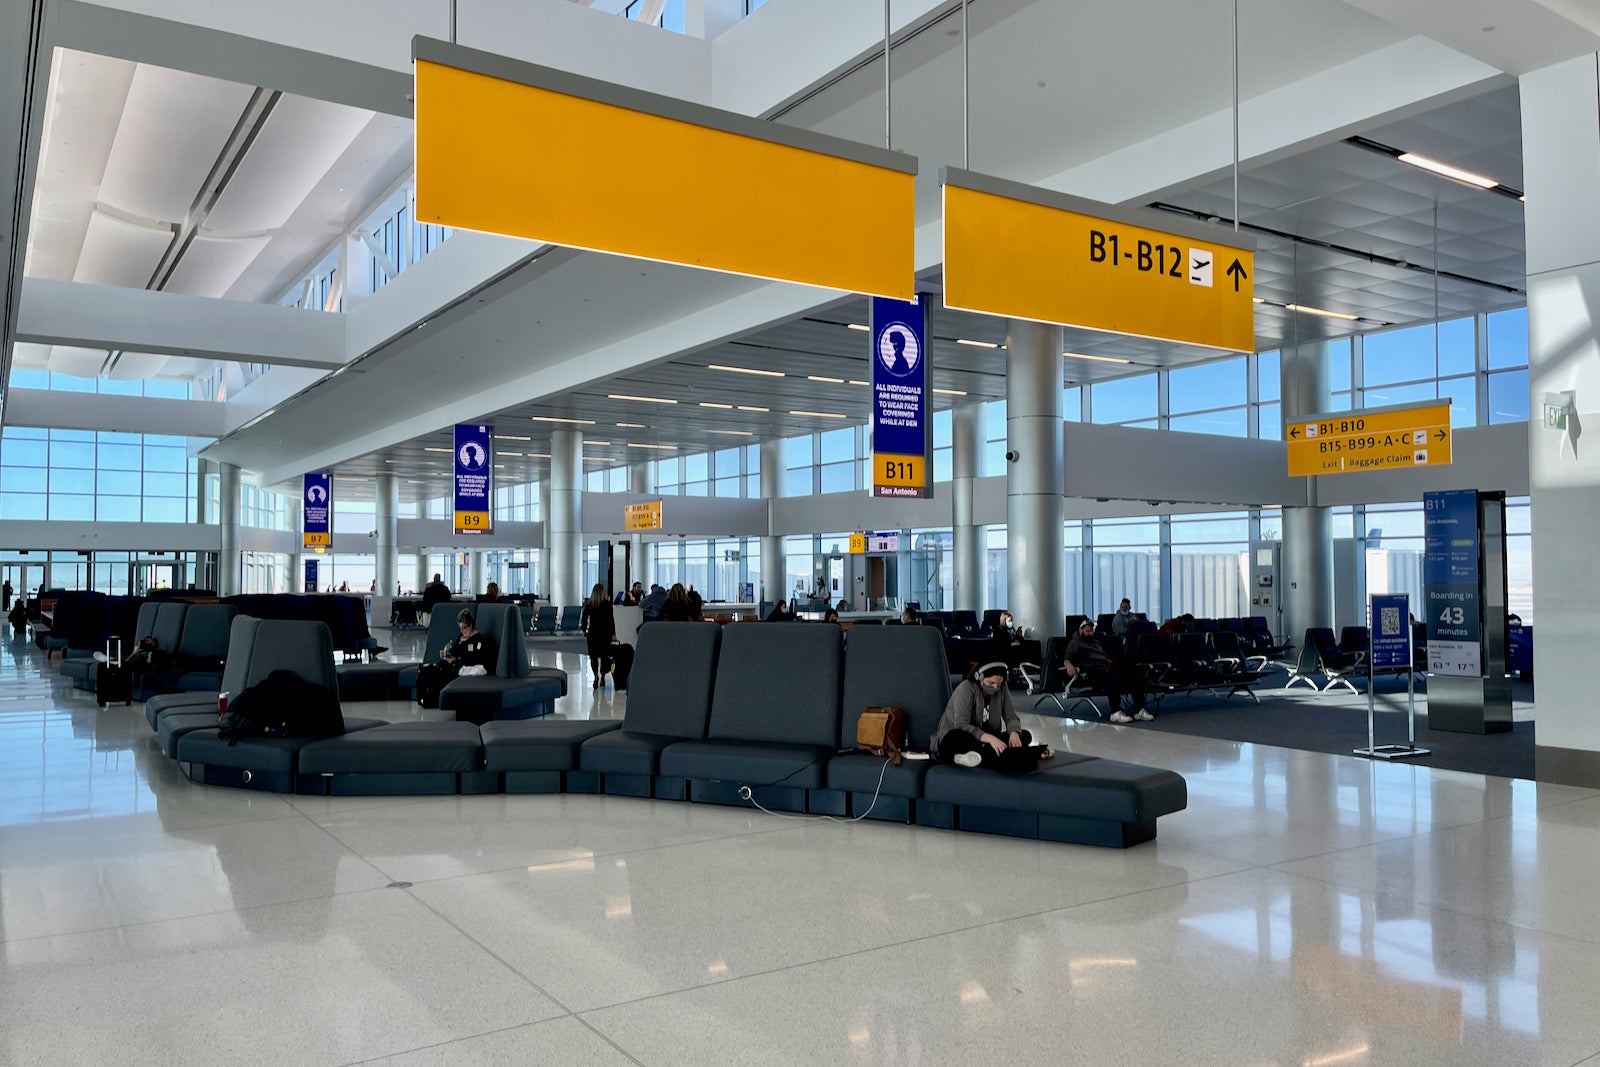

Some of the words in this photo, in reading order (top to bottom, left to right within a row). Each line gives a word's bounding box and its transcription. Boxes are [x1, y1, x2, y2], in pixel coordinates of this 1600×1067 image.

[1090, 230, 1182, 278] B1-B12
[876, 383, 886, 391] ALL
[887, 384, 921, 394] INDIVIDUALS
[887, 401, 904, 409] WEAR
[904, 402, 918, 411] FACE
[882, 409, 914, 418] COVERINGS
[880, 417, 897, 426] WHILE
[898, 418, 905, 426] AT
[1320, 419, 1365, 435] B1-B10
[1322, 461, 1337, 469] Exit
[1350, 457, 1384, 467] Baggage
[1387, 454, 1411, 463] Claim
[886, 461, 913, 480] B11
[881, 486, 892, 494] San
[893, 487, 918, 496] Antonio
[1426, 499, 1445, 510] B11
[464, 515, 480, 525] B9
[852, 539, 861, 548] B9
[1430, 591, 1464, 601] Boarding
[1439, 606, 1464, 625] 43
[1437, 628, 1468, 636] minutes
